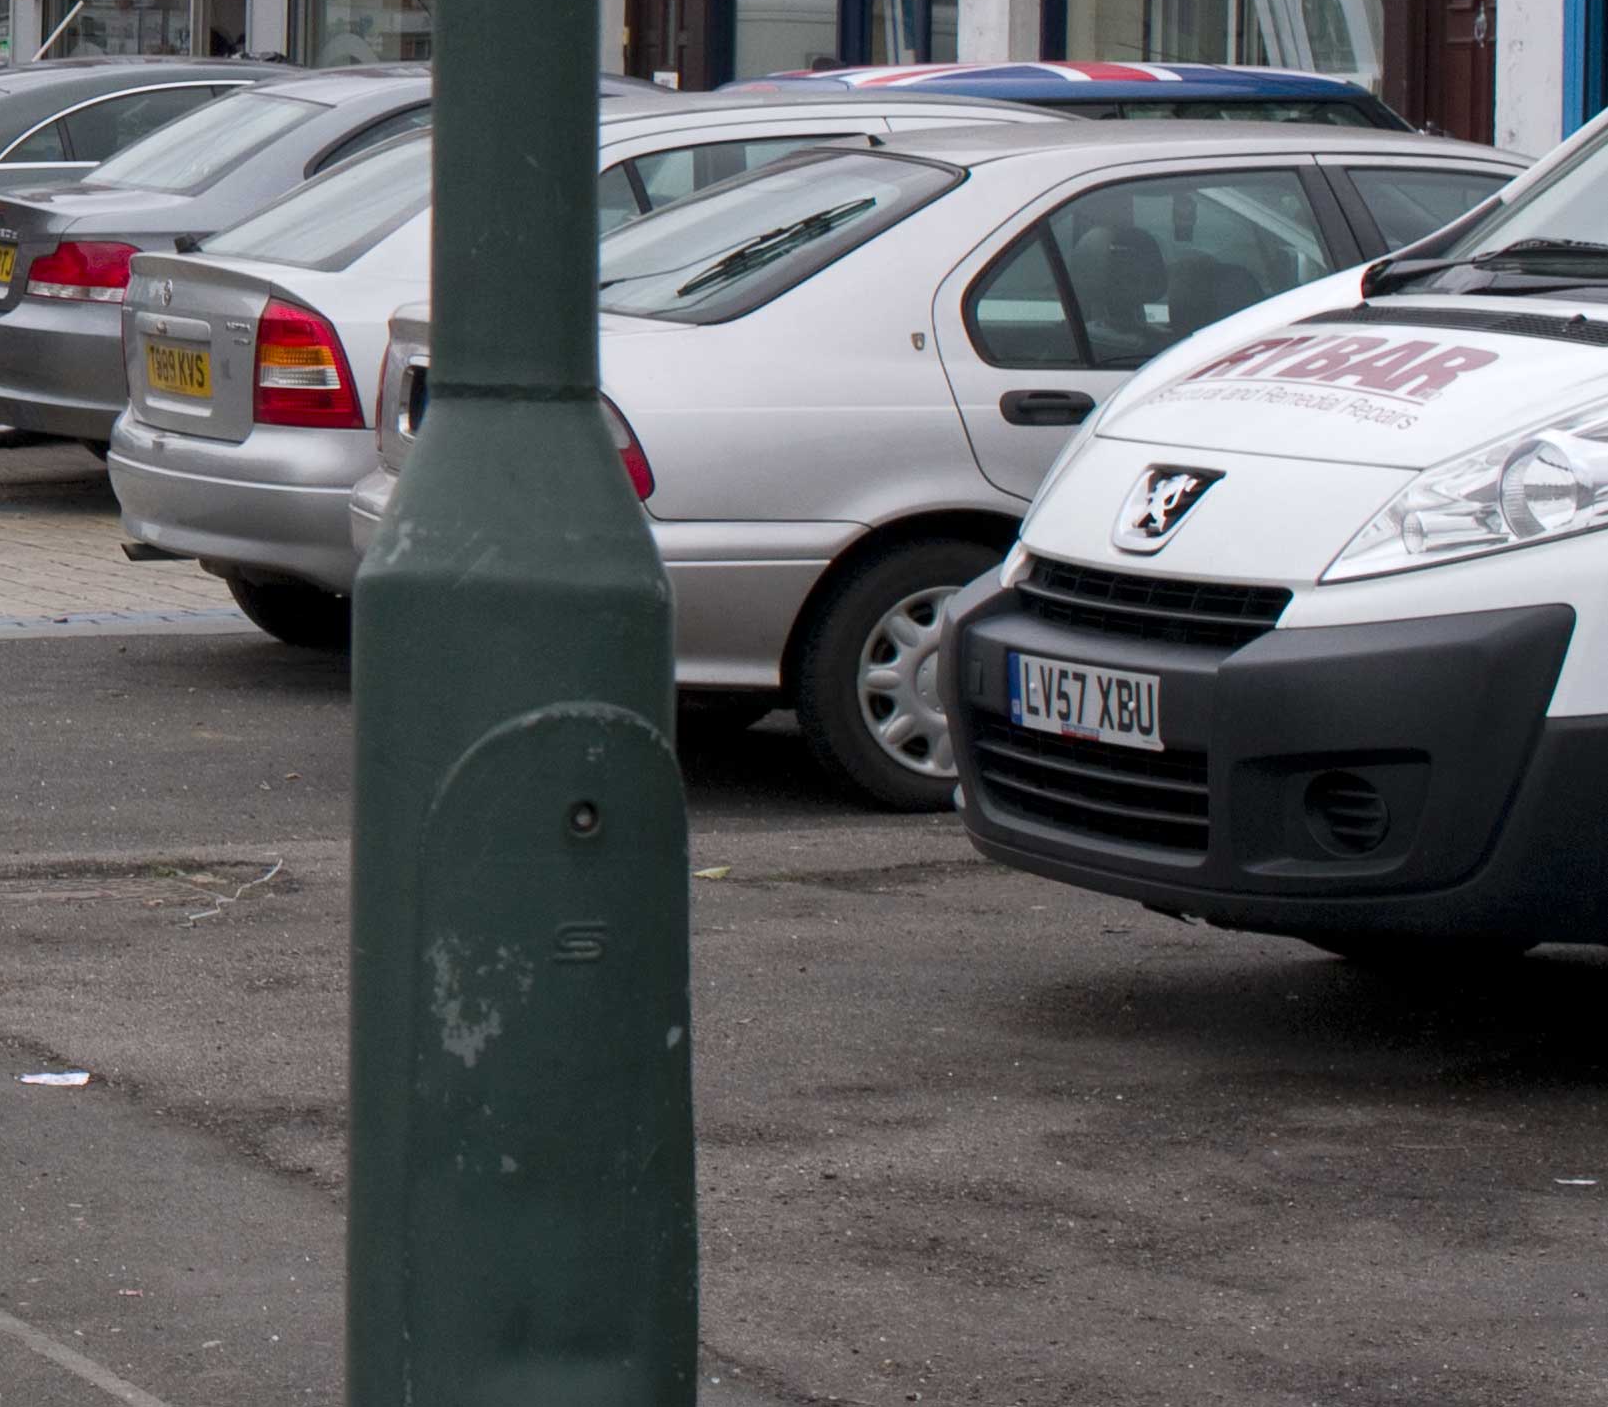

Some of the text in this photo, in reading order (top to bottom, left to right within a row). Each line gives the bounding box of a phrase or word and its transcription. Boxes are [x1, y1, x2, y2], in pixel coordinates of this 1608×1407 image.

[177, 352, 205, 388] KVS
[1185, 336, 1499, 396] RYBAR
[1348, 398, 1419, 431] Repairs
[1025, 662, 1154, 737] LV57 XBU
